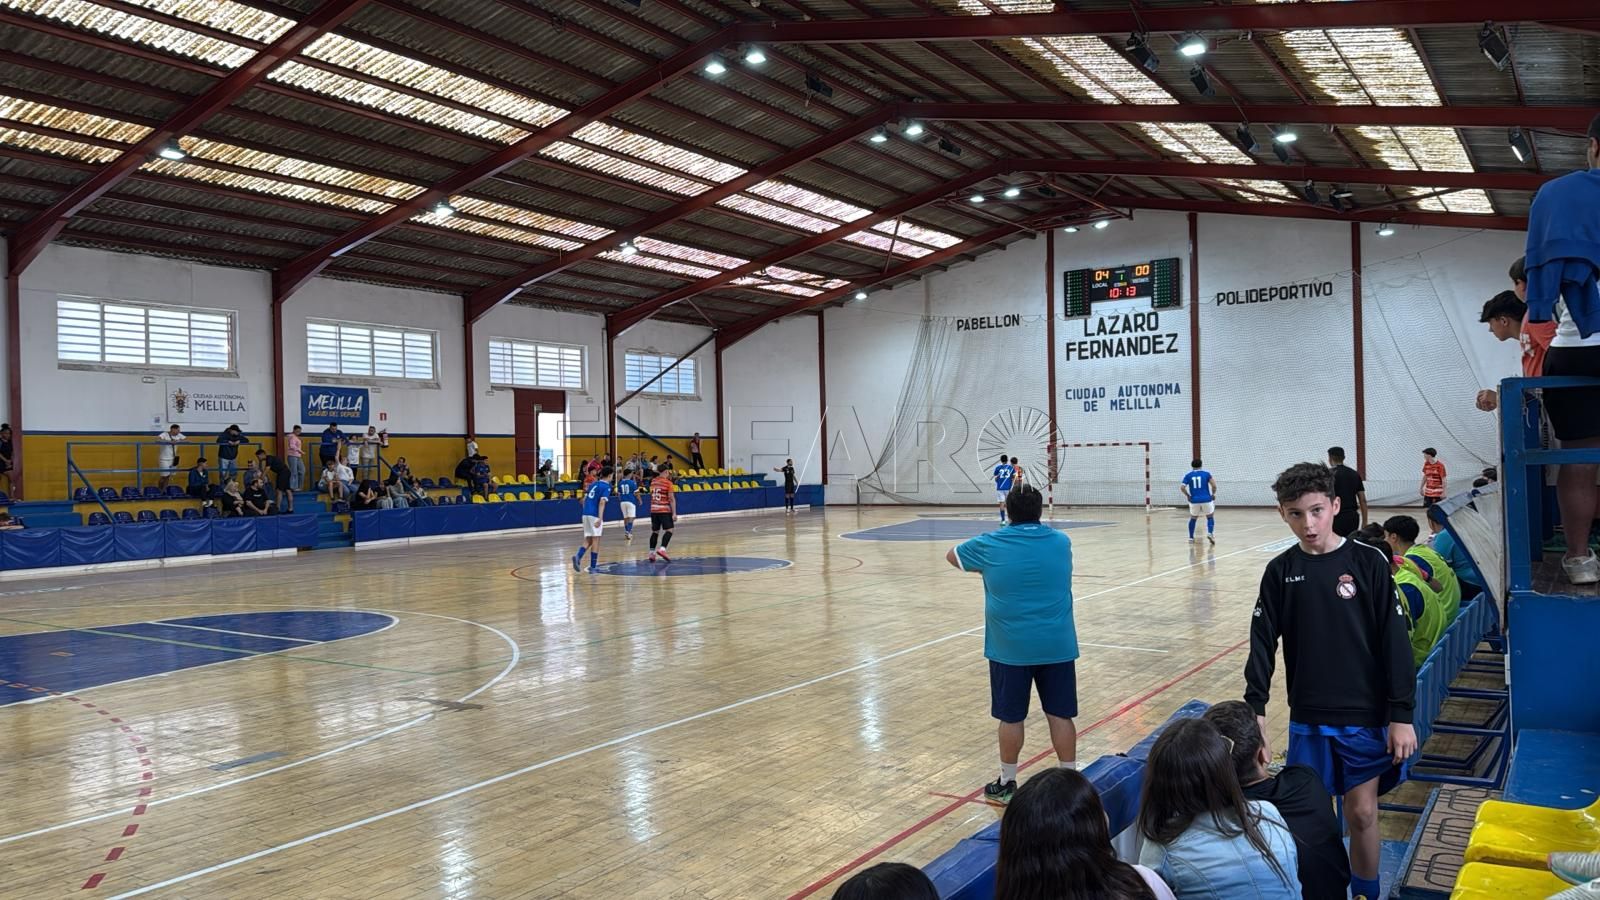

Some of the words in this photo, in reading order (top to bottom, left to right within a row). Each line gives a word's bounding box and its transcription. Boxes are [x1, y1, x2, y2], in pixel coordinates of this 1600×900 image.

[1095, 271, 1110, 281] 04
[1135, 265, 1150, 276] 00
[1109, 286, 1137, 298] 10:13
[1216, 281, 1333, 306] POLIDEPORTIVO
[957, 313, 1020, 332] PABELLON
[1084, 311, 1159, 337] LAZARO
[1065, 333, 1178, 361] FERNANDEZ
[1065, 387, 1106, 400] CIUDAD
[1118, 383, 1181, 398] AUTONOMA
[194, 400, 246, 412] MELILLA
[308, 394, 364, 411] MELILLA
[1083, 401, 1099, 412] DE
[1110, 398, 1161, 411] MELILLA
[999, 469, 1011, 479] 23
[621, 484, 630, 495] 10
[1191, 475, 1202, 489] 11
[588, 485, 596, 499] 6
